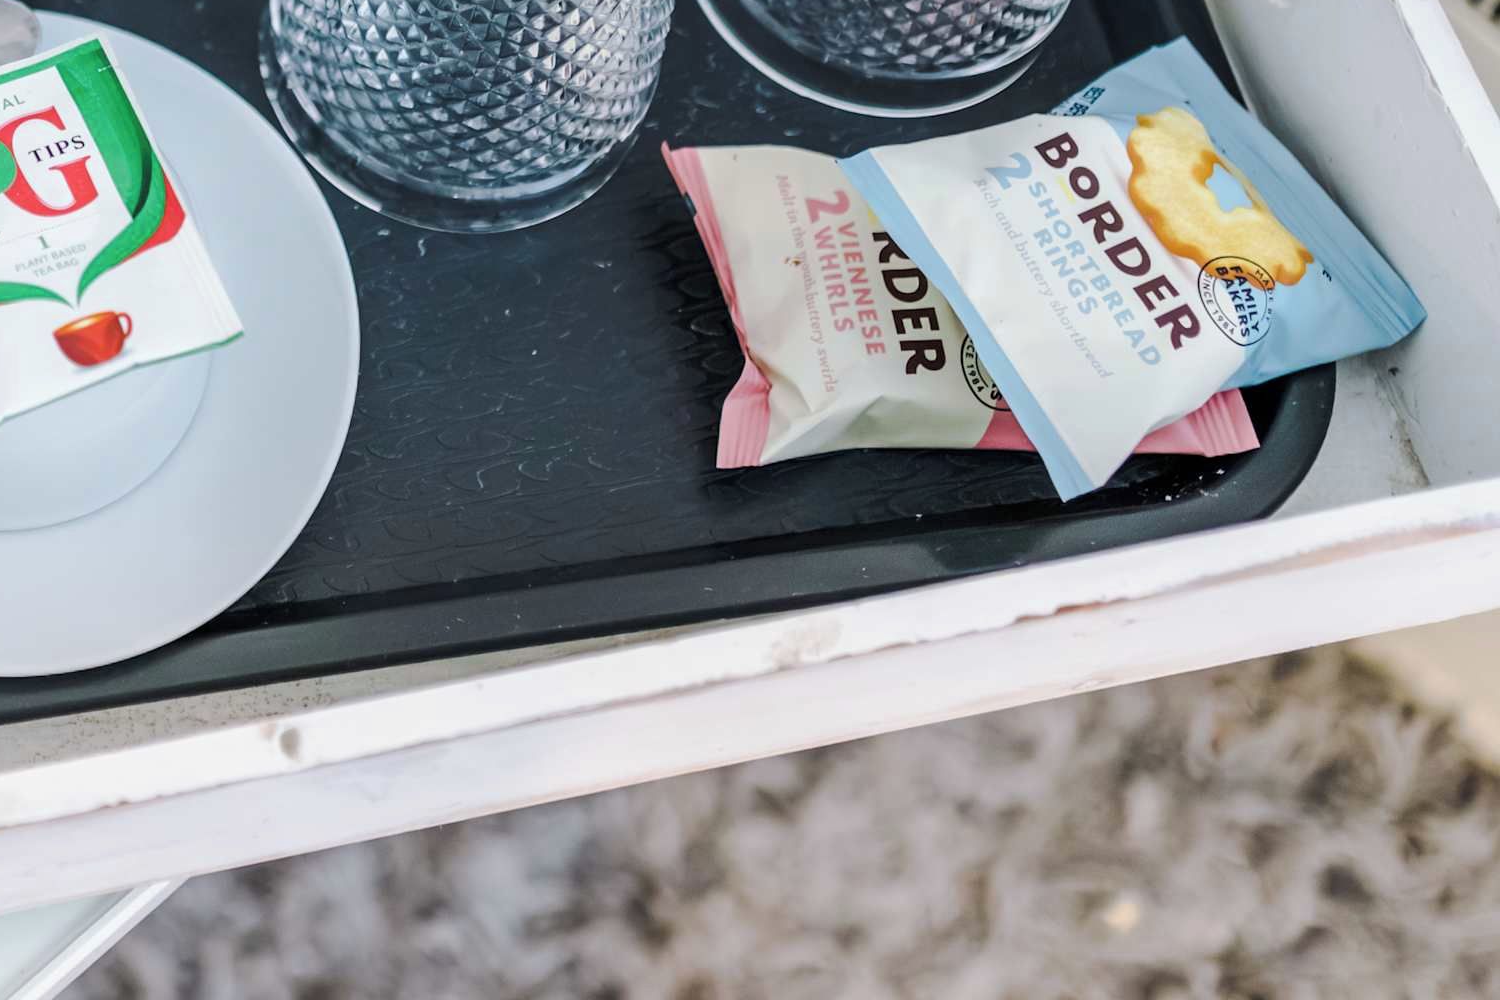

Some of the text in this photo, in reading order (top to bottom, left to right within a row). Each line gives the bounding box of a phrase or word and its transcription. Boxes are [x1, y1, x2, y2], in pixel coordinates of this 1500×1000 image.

[28, 134, 86, 164] TIPS
[984, 151, 1033, 190] 2
[805, 189, 851, 224] 2
[15, 244, 86, 272] PLANT BASED
[33, 257, 79, 278] TEA BAG
[1029, 181, 1162, 368] SHORTBREAD
[1033, 228, 1100, 316] RINGS
[1034, 132, 1202, 352] BORDER
[814, 226, 854, 332] WHIRLS
[837, 221, 886, 355] VIENNESE
[873, 230, 946, 375] RDER
[974, 177, 1114, 379] Rich and buttery shortbread
[1202, 273, 1235, 335] SINCE 1984
[1215, 266, 1250, 337] BAKERS
[1229, 266, 1260, 332] FAMILY
[817, 347, 837, 393] swirls
[967, 364, 984, 392] 1984
